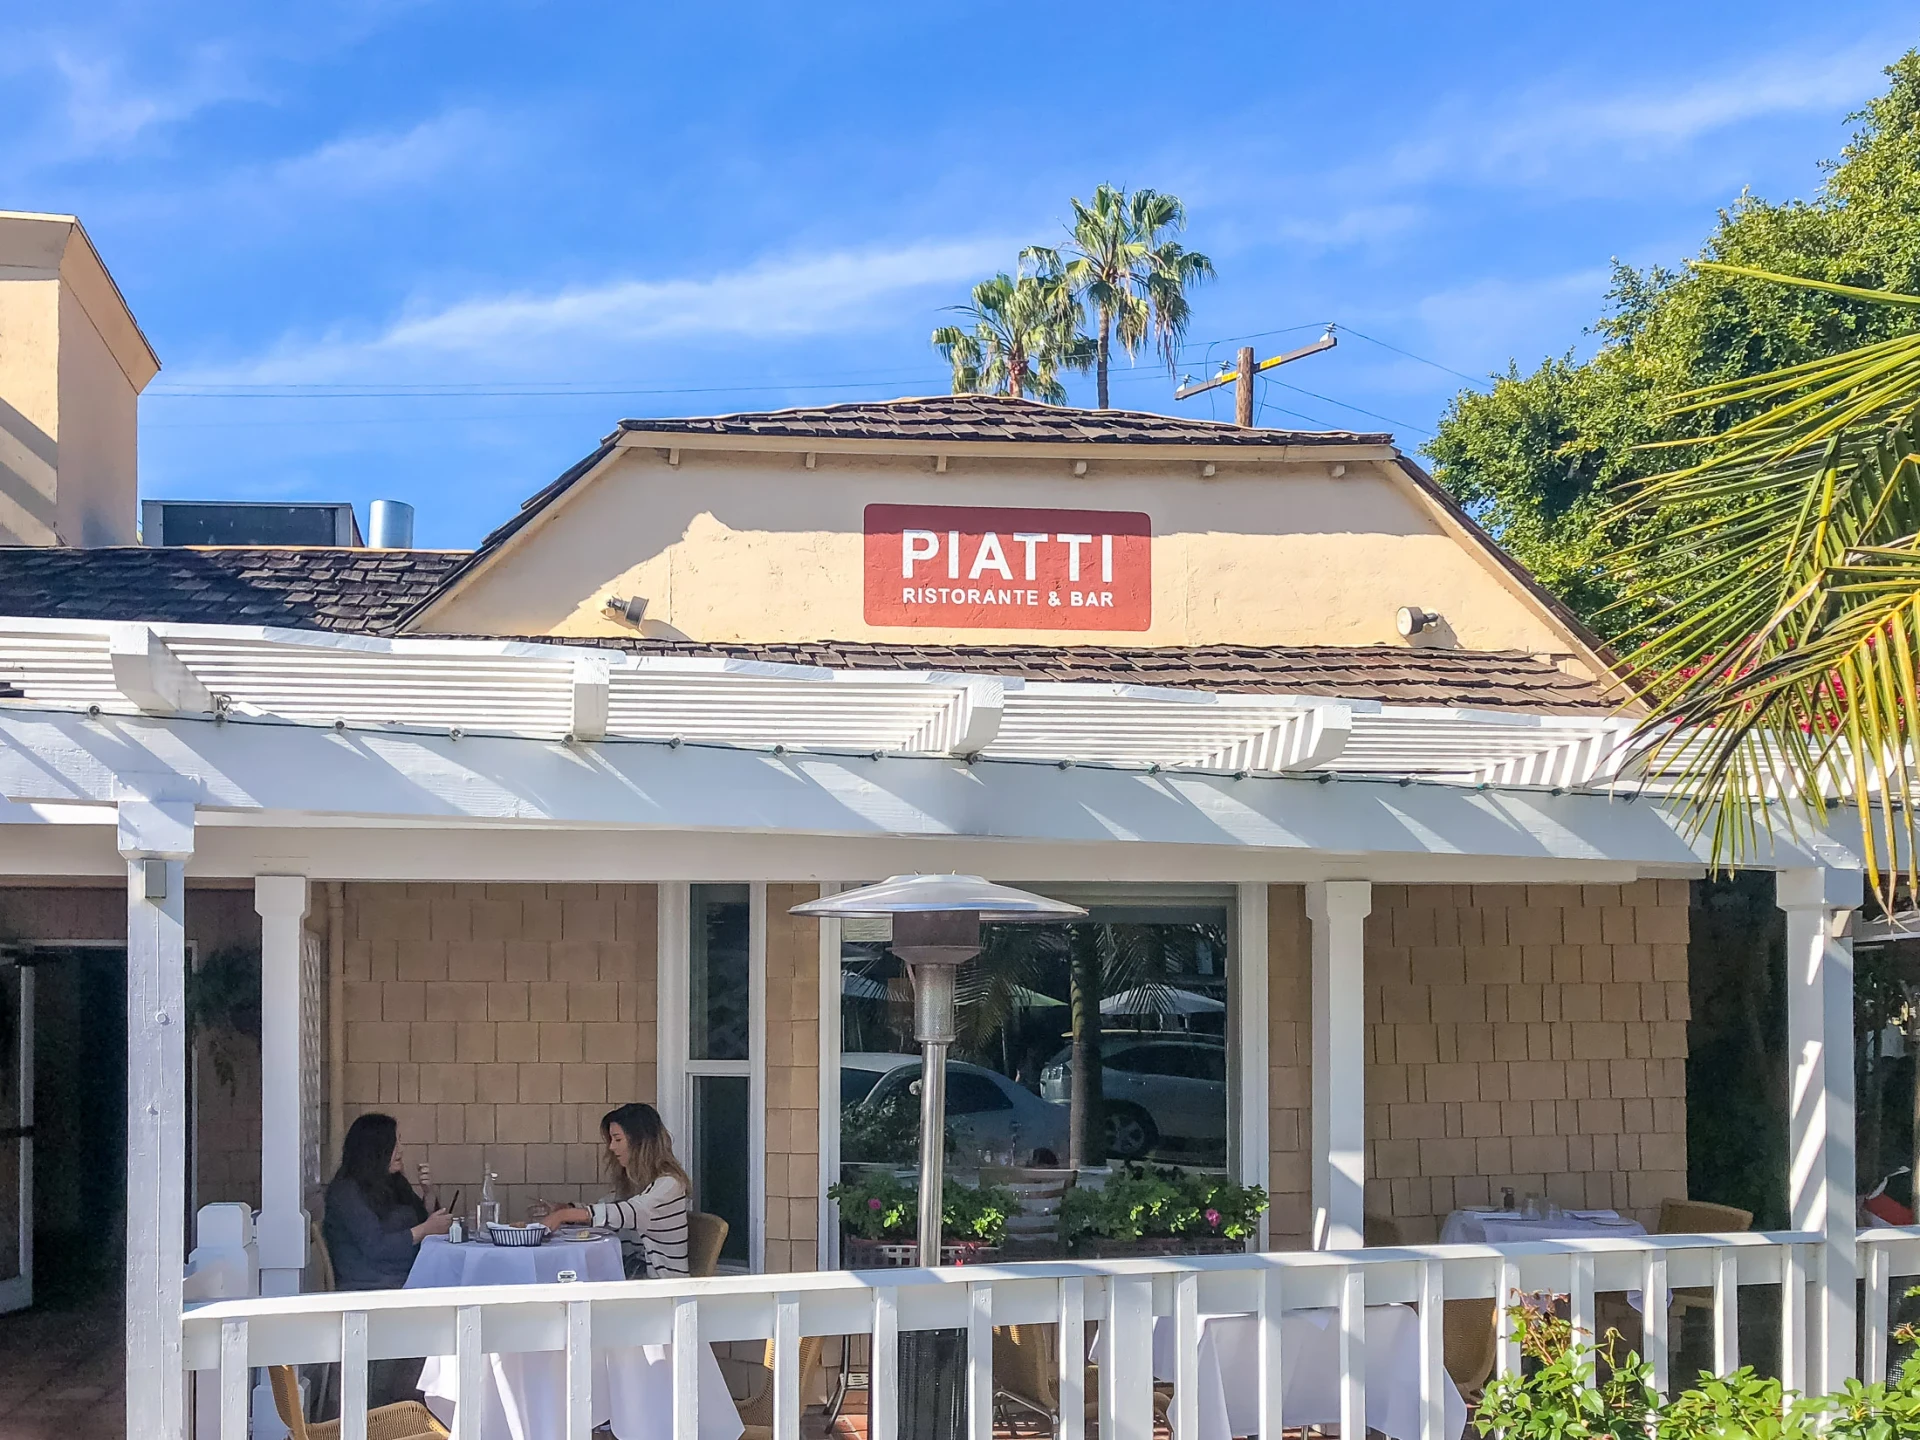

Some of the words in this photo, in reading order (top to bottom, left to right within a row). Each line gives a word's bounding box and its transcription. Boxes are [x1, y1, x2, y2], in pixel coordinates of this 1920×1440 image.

[902, 529, 1113, 583] PIATTI
[902, 587, 1039, 606] RISTORANTE
[1047, 591, 1061, 607] &
[1070, 591, 1114, 607] BAR
